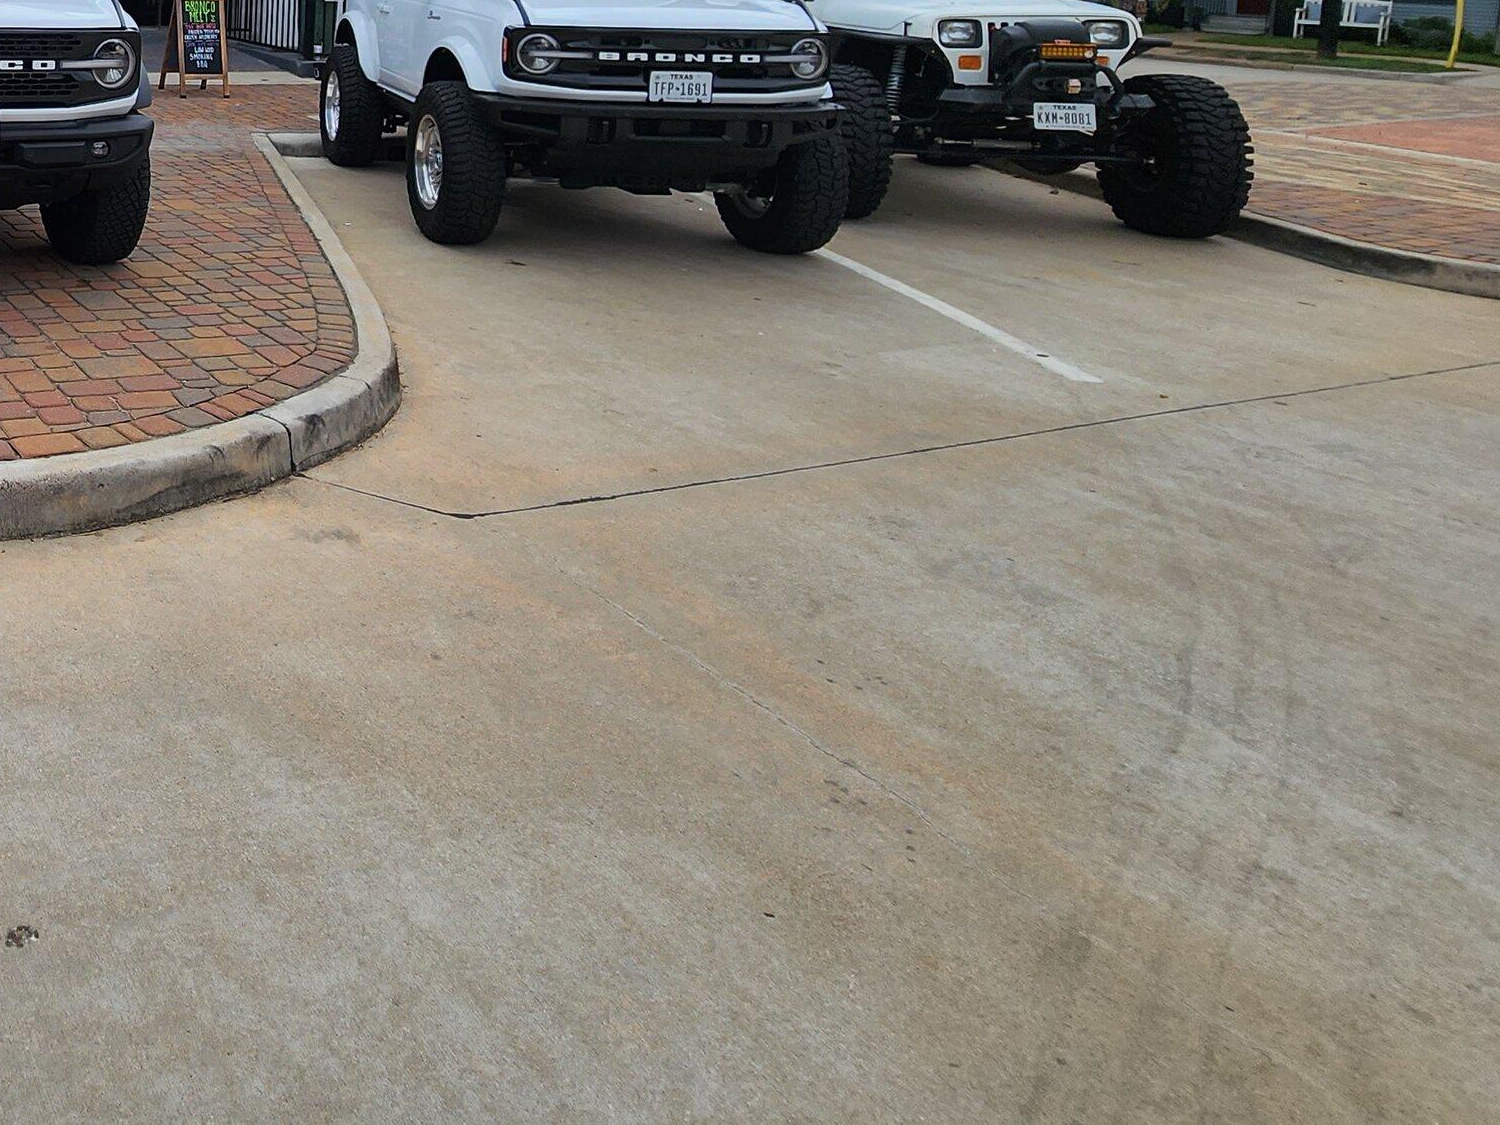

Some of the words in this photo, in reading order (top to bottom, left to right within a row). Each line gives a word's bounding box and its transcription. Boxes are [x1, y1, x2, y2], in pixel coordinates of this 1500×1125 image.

[185, 0, 216, 13] BRONCO
[598, 51, 760, 63] BRONCO
[681, 83, 708, 96] 1691
